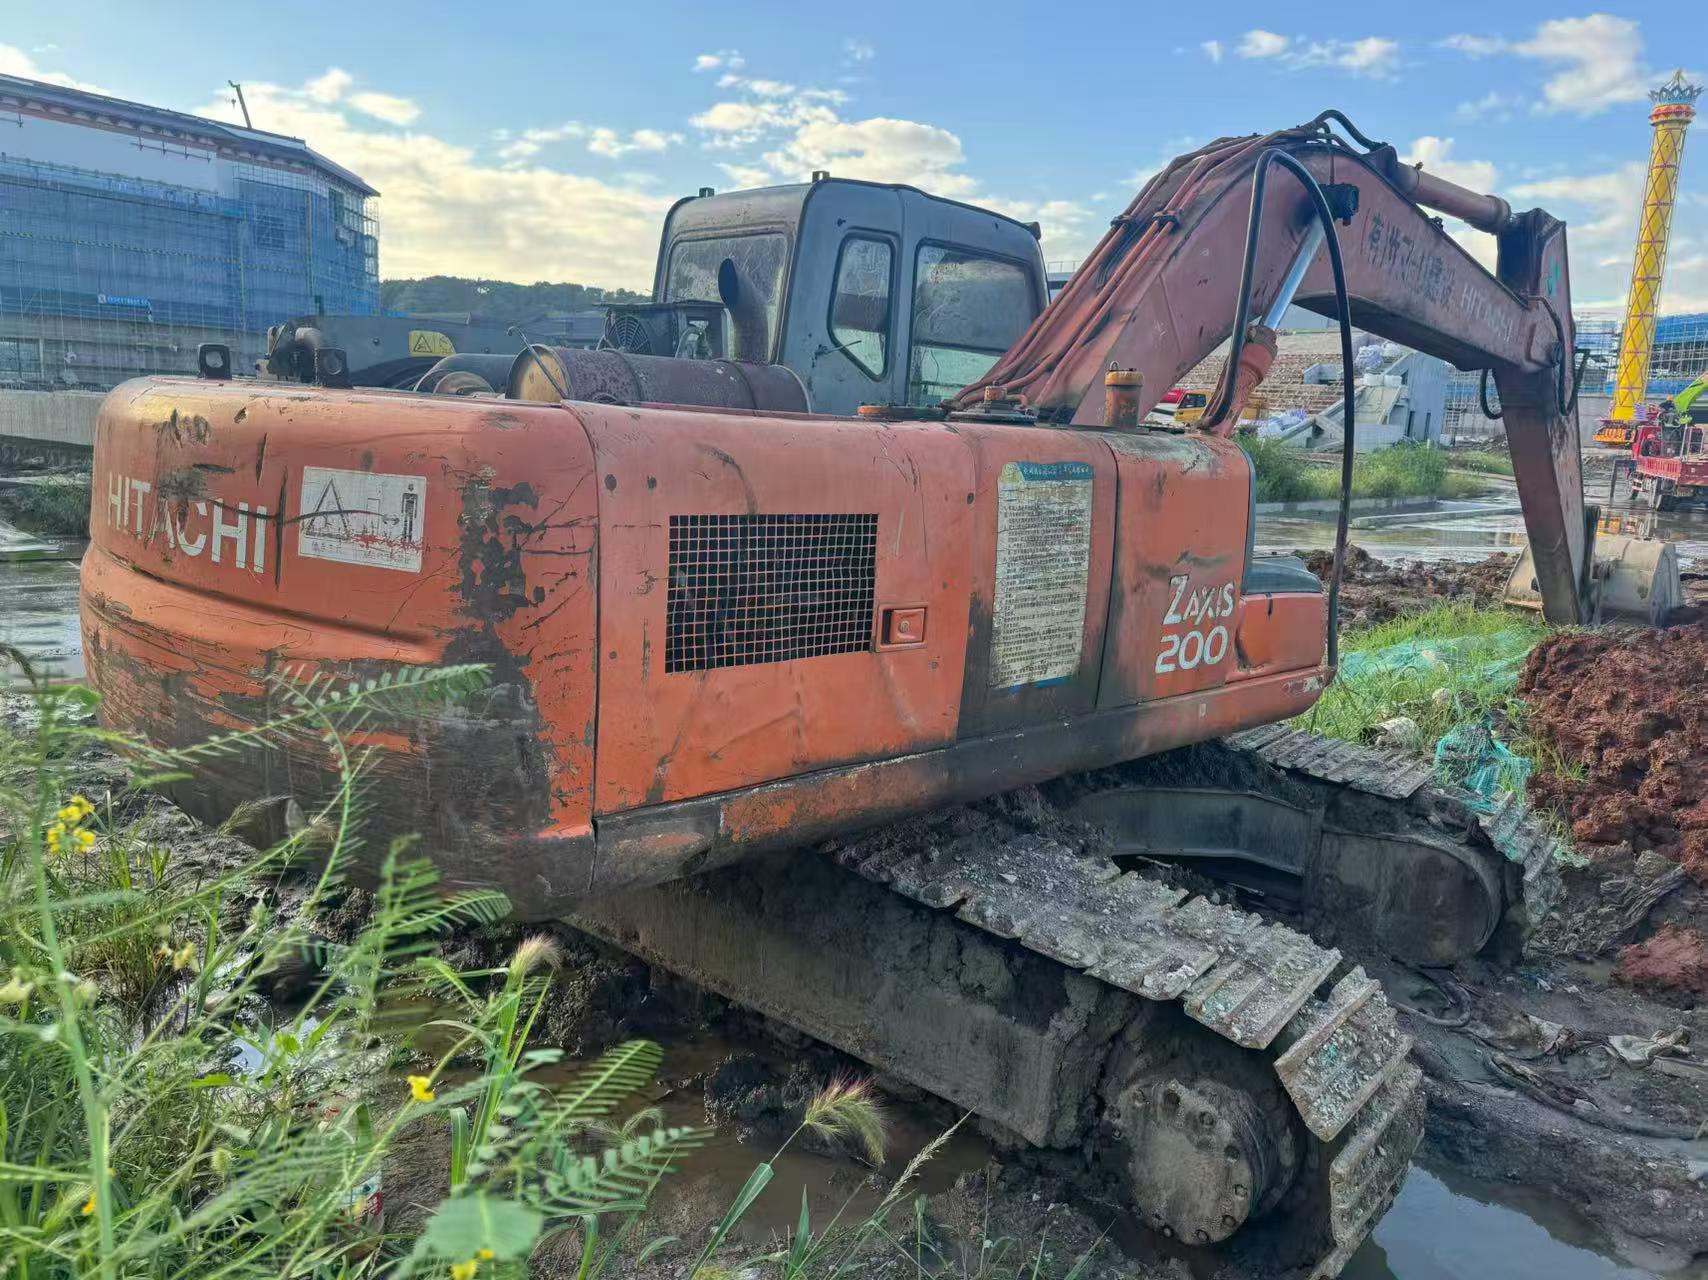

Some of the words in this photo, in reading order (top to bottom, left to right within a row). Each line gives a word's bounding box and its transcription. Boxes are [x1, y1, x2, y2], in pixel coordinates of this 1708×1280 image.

[107, 471, 268, 574] HITACHI
[1163, 574, 1234, 625] ZAXIS
[1155, 625, 1229, 673] 200
